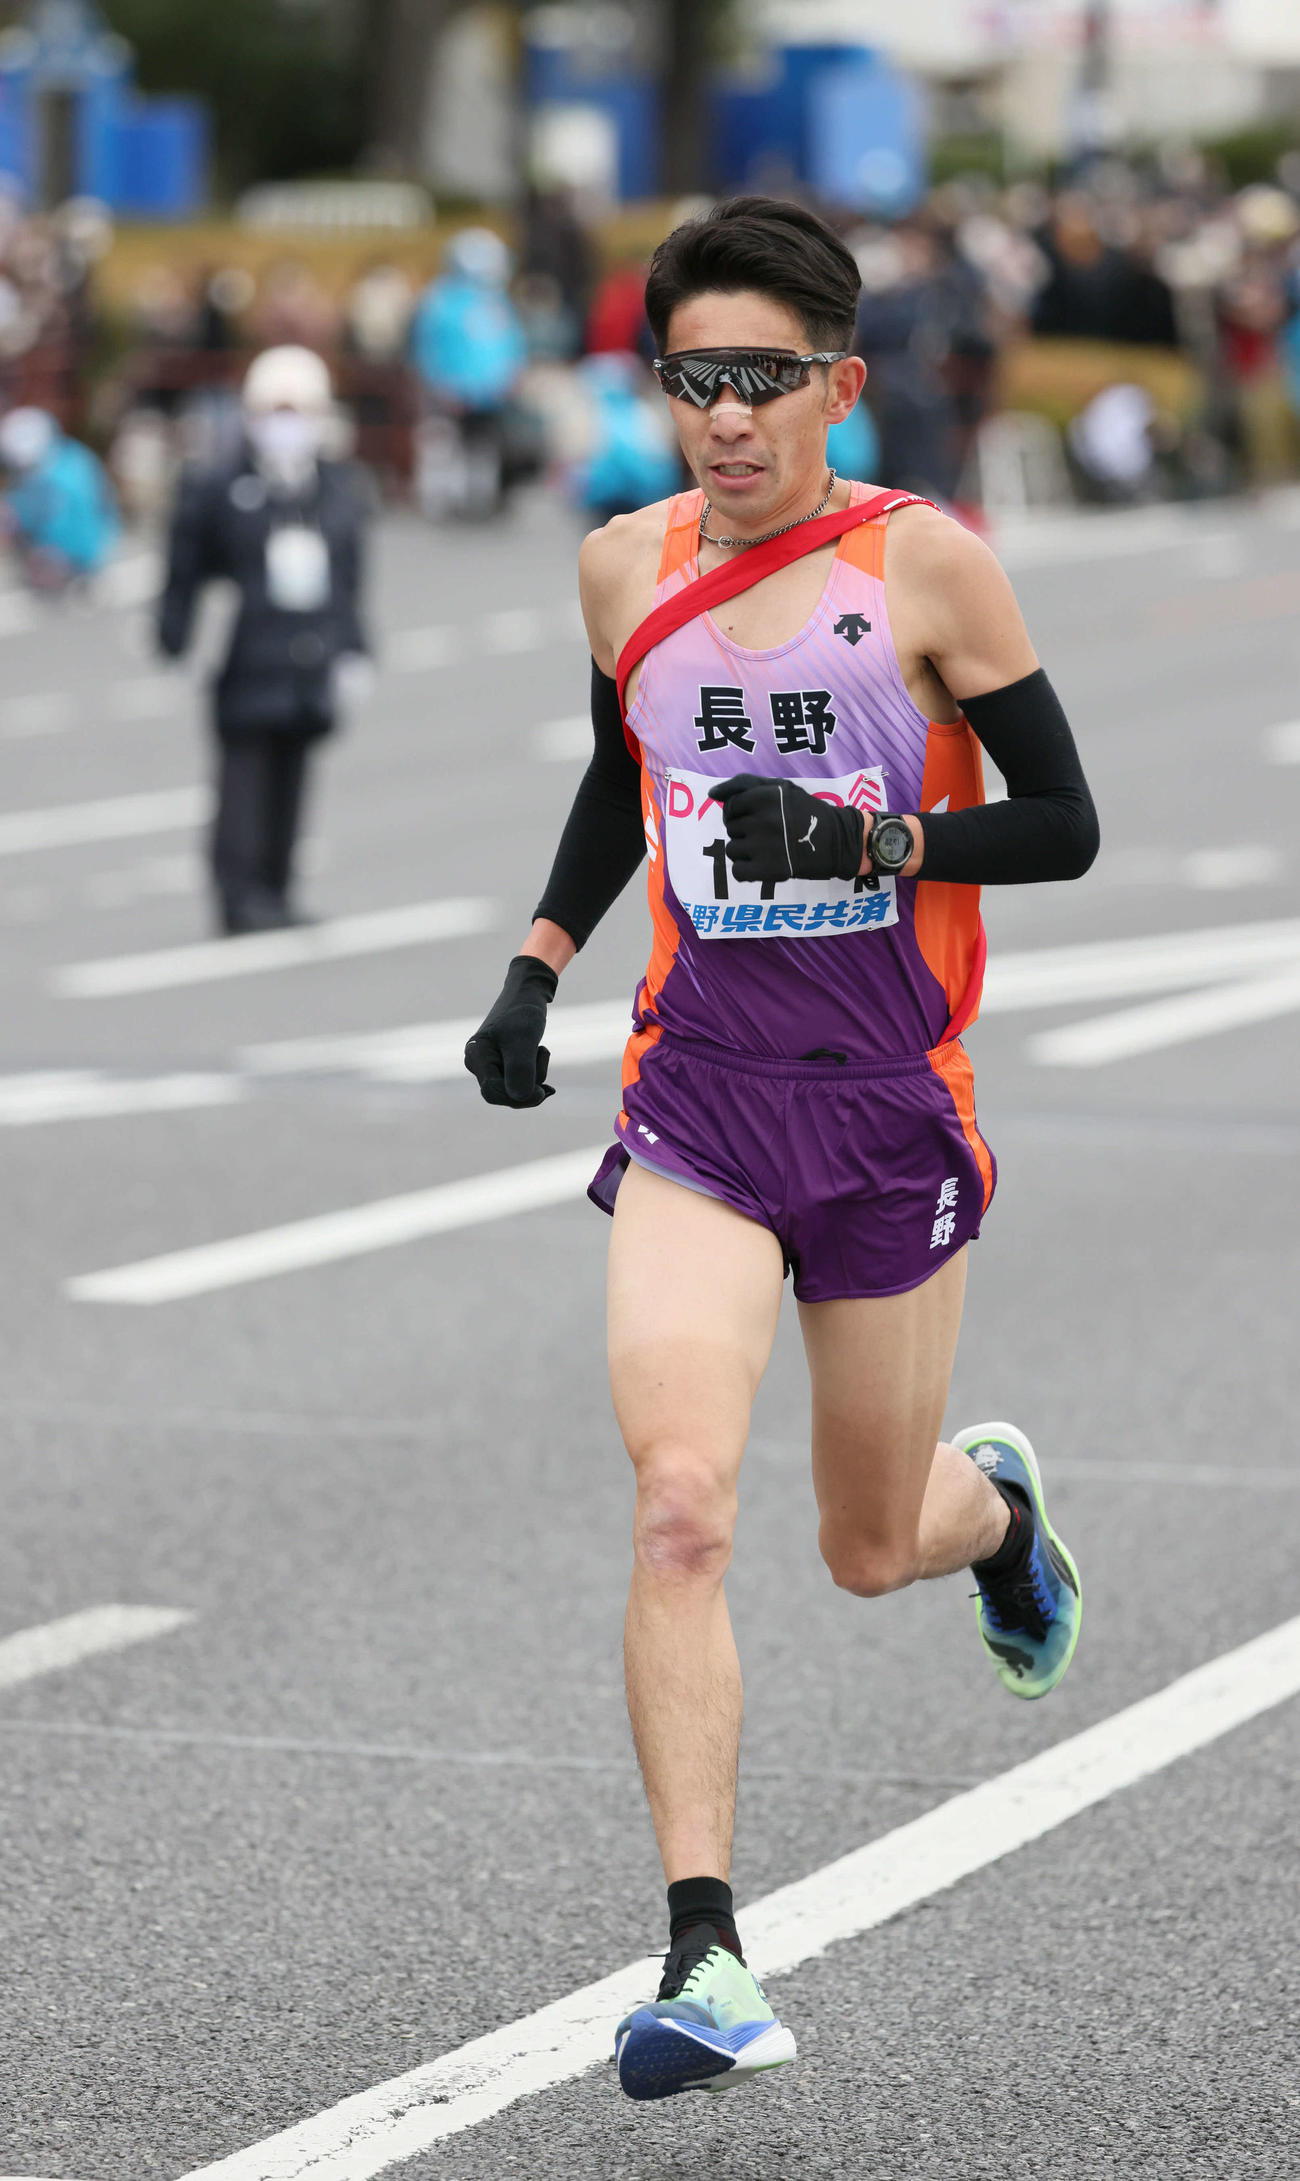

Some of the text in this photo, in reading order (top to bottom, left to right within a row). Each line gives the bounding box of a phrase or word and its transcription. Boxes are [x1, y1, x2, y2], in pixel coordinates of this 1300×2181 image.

[693, 685, 838, 755] 長野
[682, 891, 891, 933] 野県民共済
[929, 1177, 959, 1249] 長野
